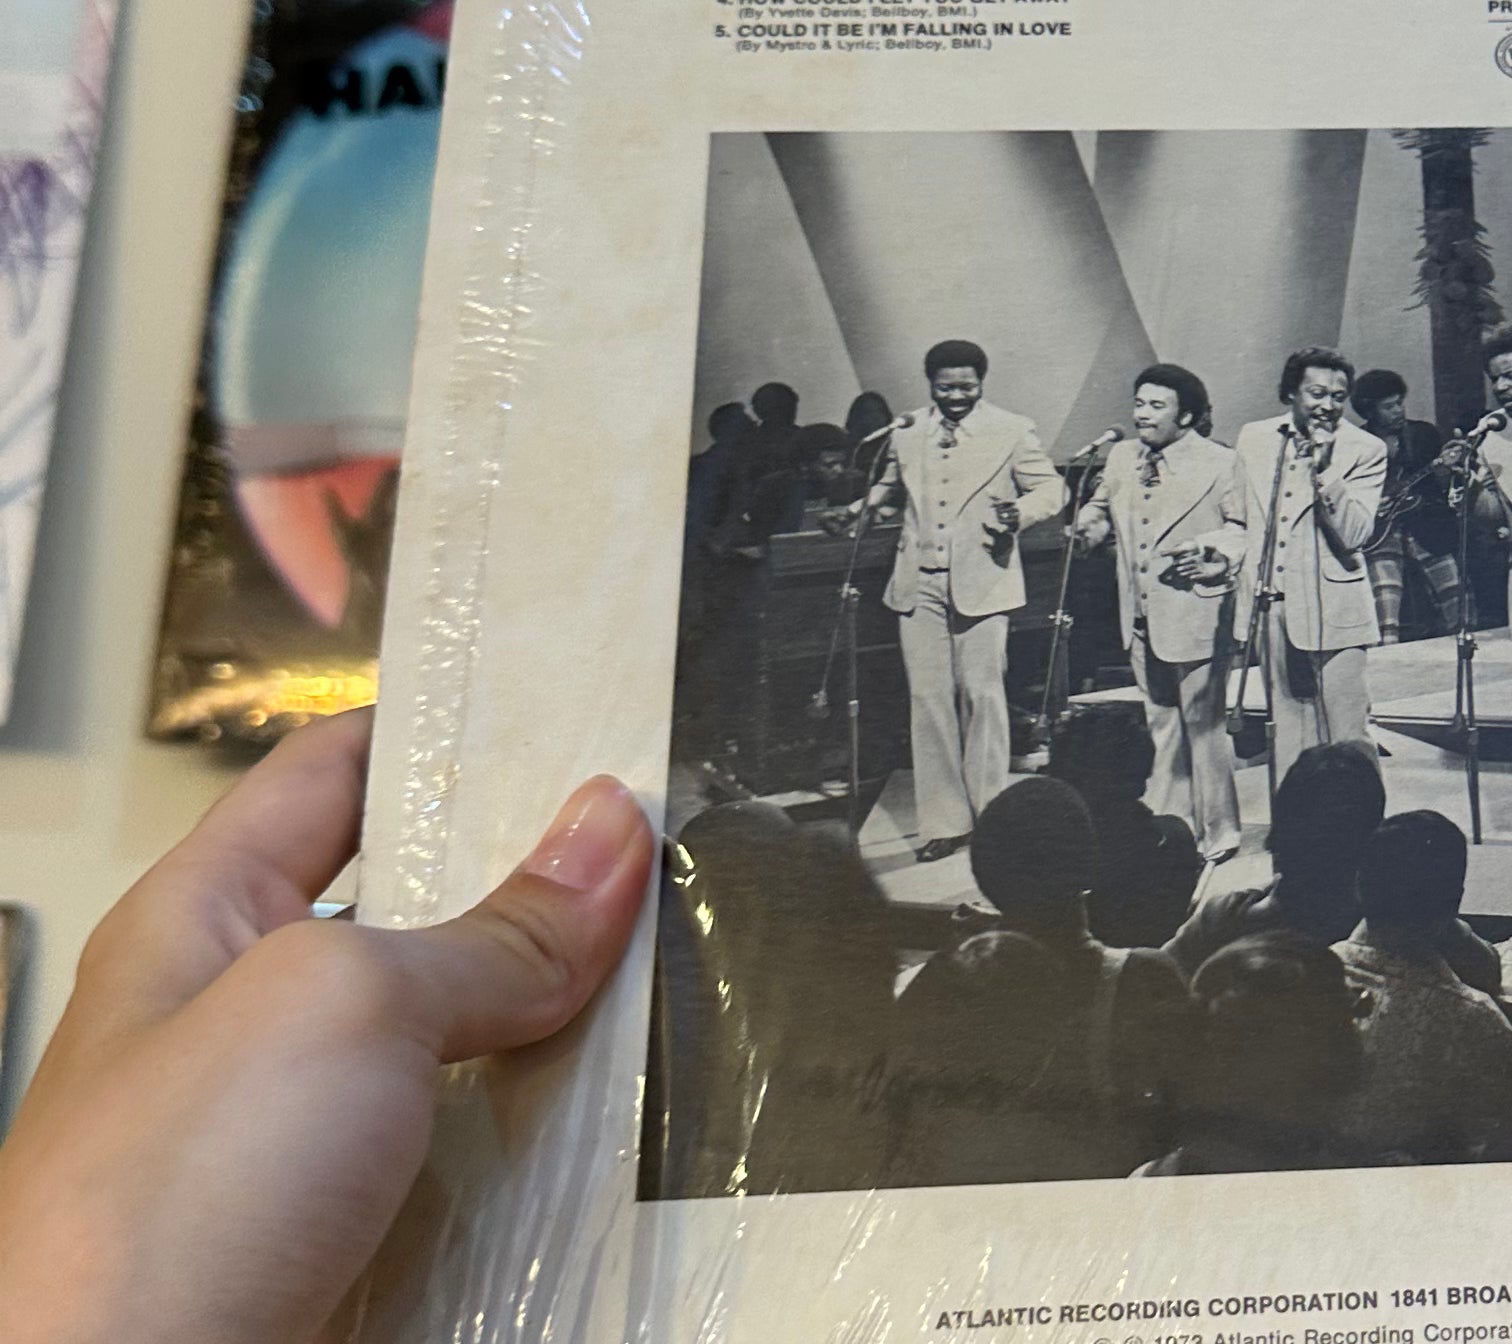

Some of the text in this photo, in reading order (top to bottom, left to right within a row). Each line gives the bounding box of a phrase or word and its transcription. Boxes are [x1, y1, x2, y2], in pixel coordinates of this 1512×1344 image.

[715, 22, 1072, 38] 5. COULD IT BE I'M FALLING IN LOVE
[936, 1306, 1052, 1330] ATLANTIC
[1059, 1300, 1201, 1325] RECORDING
[1208, 1291, 1378, 1317] CORPORATION
[1390, 1287, 1438, 1308] 1841
